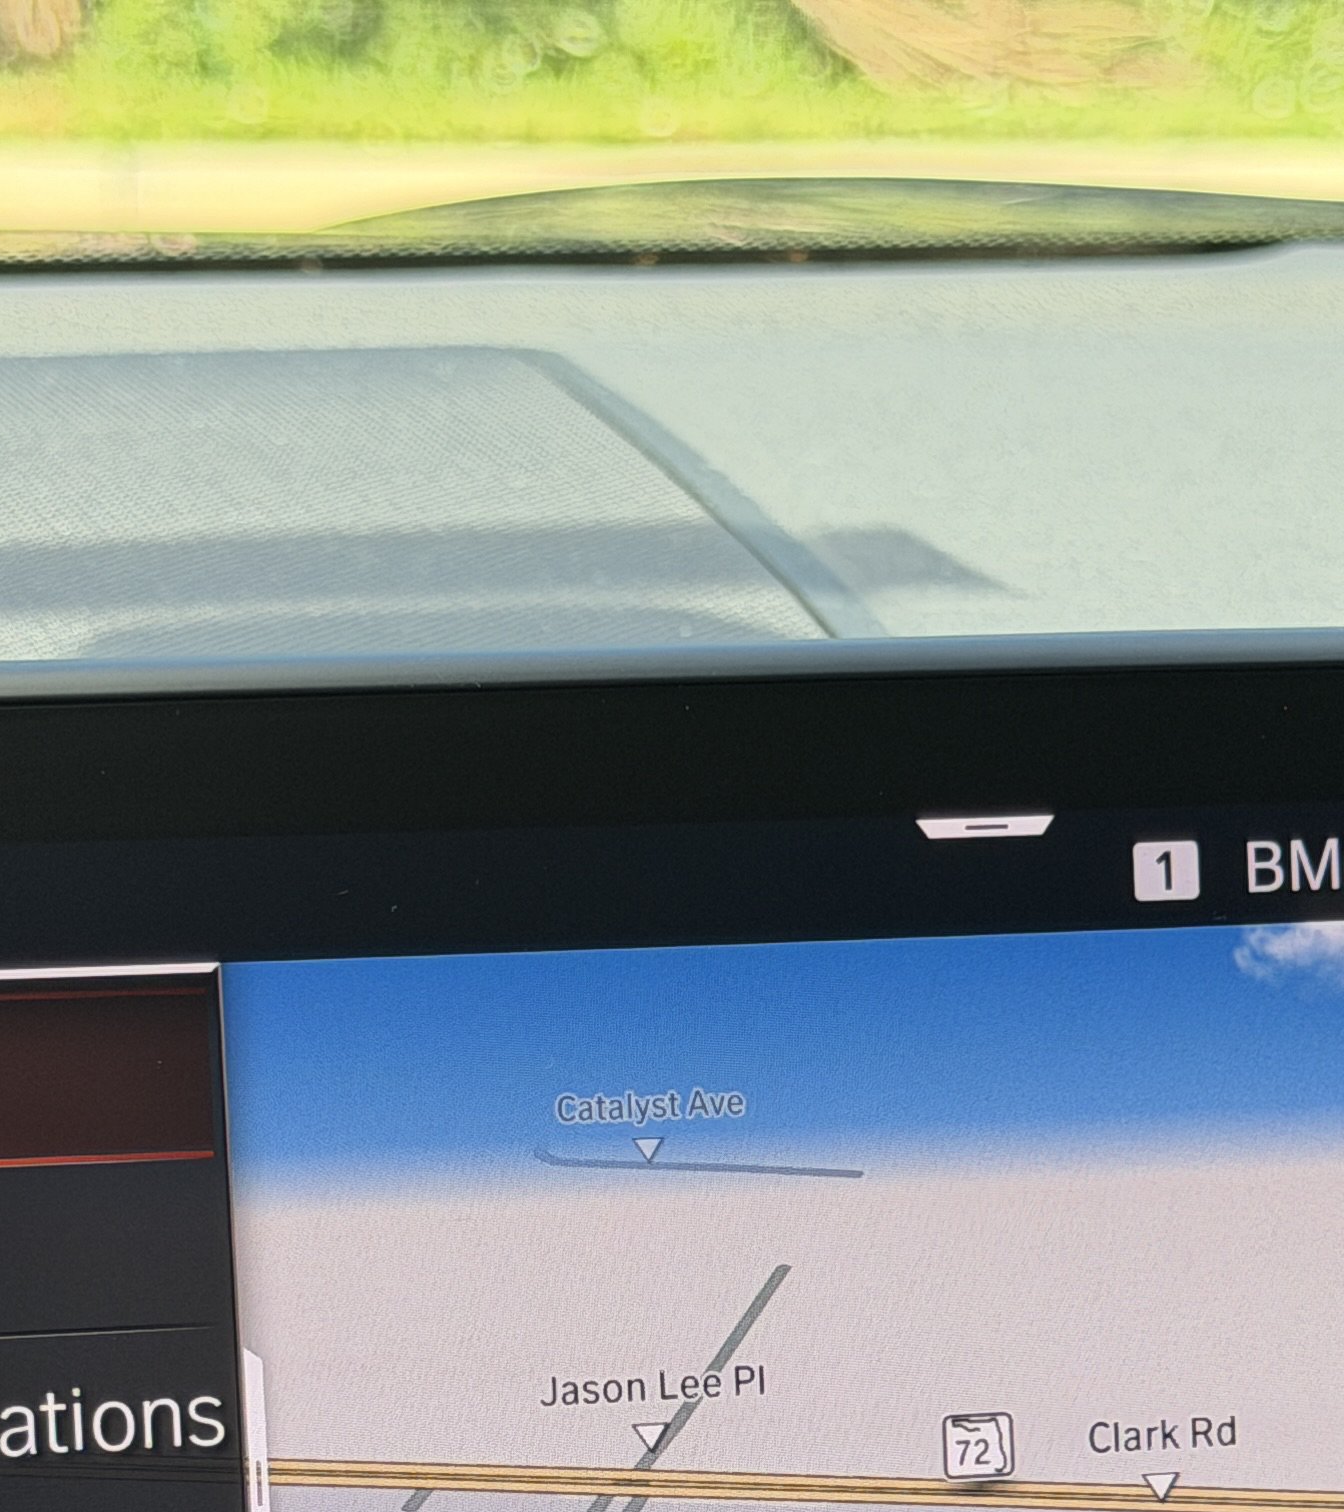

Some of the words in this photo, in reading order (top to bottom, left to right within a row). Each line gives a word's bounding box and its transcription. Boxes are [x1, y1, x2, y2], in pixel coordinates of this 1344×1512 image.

[1157, 851, 1172, 890] 1
[556, 1092, 680, 1124] Catalyst
[687, 1091, 746, 1116] Ave
[540, 1375, 646, 1407] Jason
[658, 1371, 722, 1401] Lee
[734, 1366, 765, 1395] Pl
[956, 1439, 990, 1465] 72
[1089, 1419, 1179, 1453] Clark
[1192, 1416, 1236, 1447] Rd
